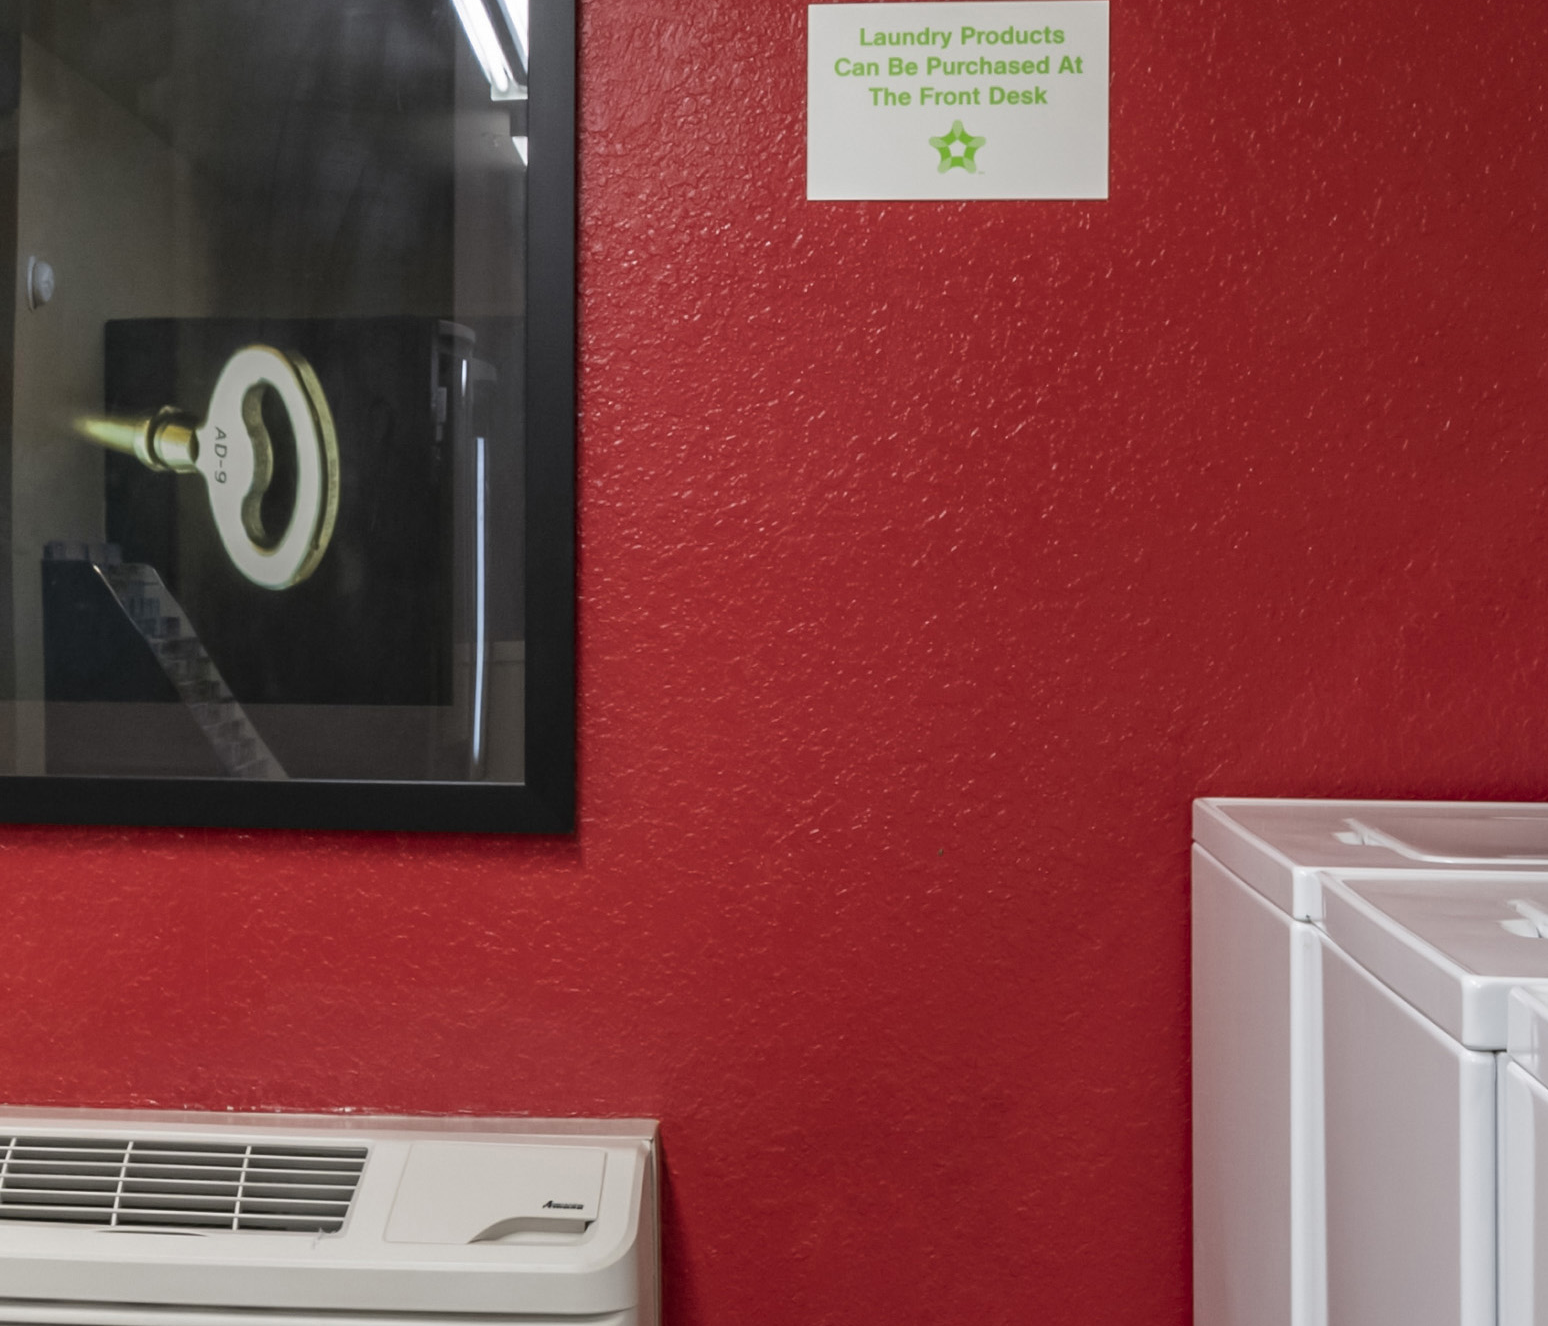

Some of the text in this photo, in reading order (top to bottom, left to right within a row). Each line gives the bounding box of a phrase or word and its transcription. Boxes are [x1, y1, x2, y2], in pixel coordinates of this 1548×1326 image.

[859, 26, 1065, 49] Laundry Products
[834, 55, 1084, 77] Can Be Purchased At
[868, 86, 1048, 106] The Front Desk
[214, 425, 228, 484] AD-9
